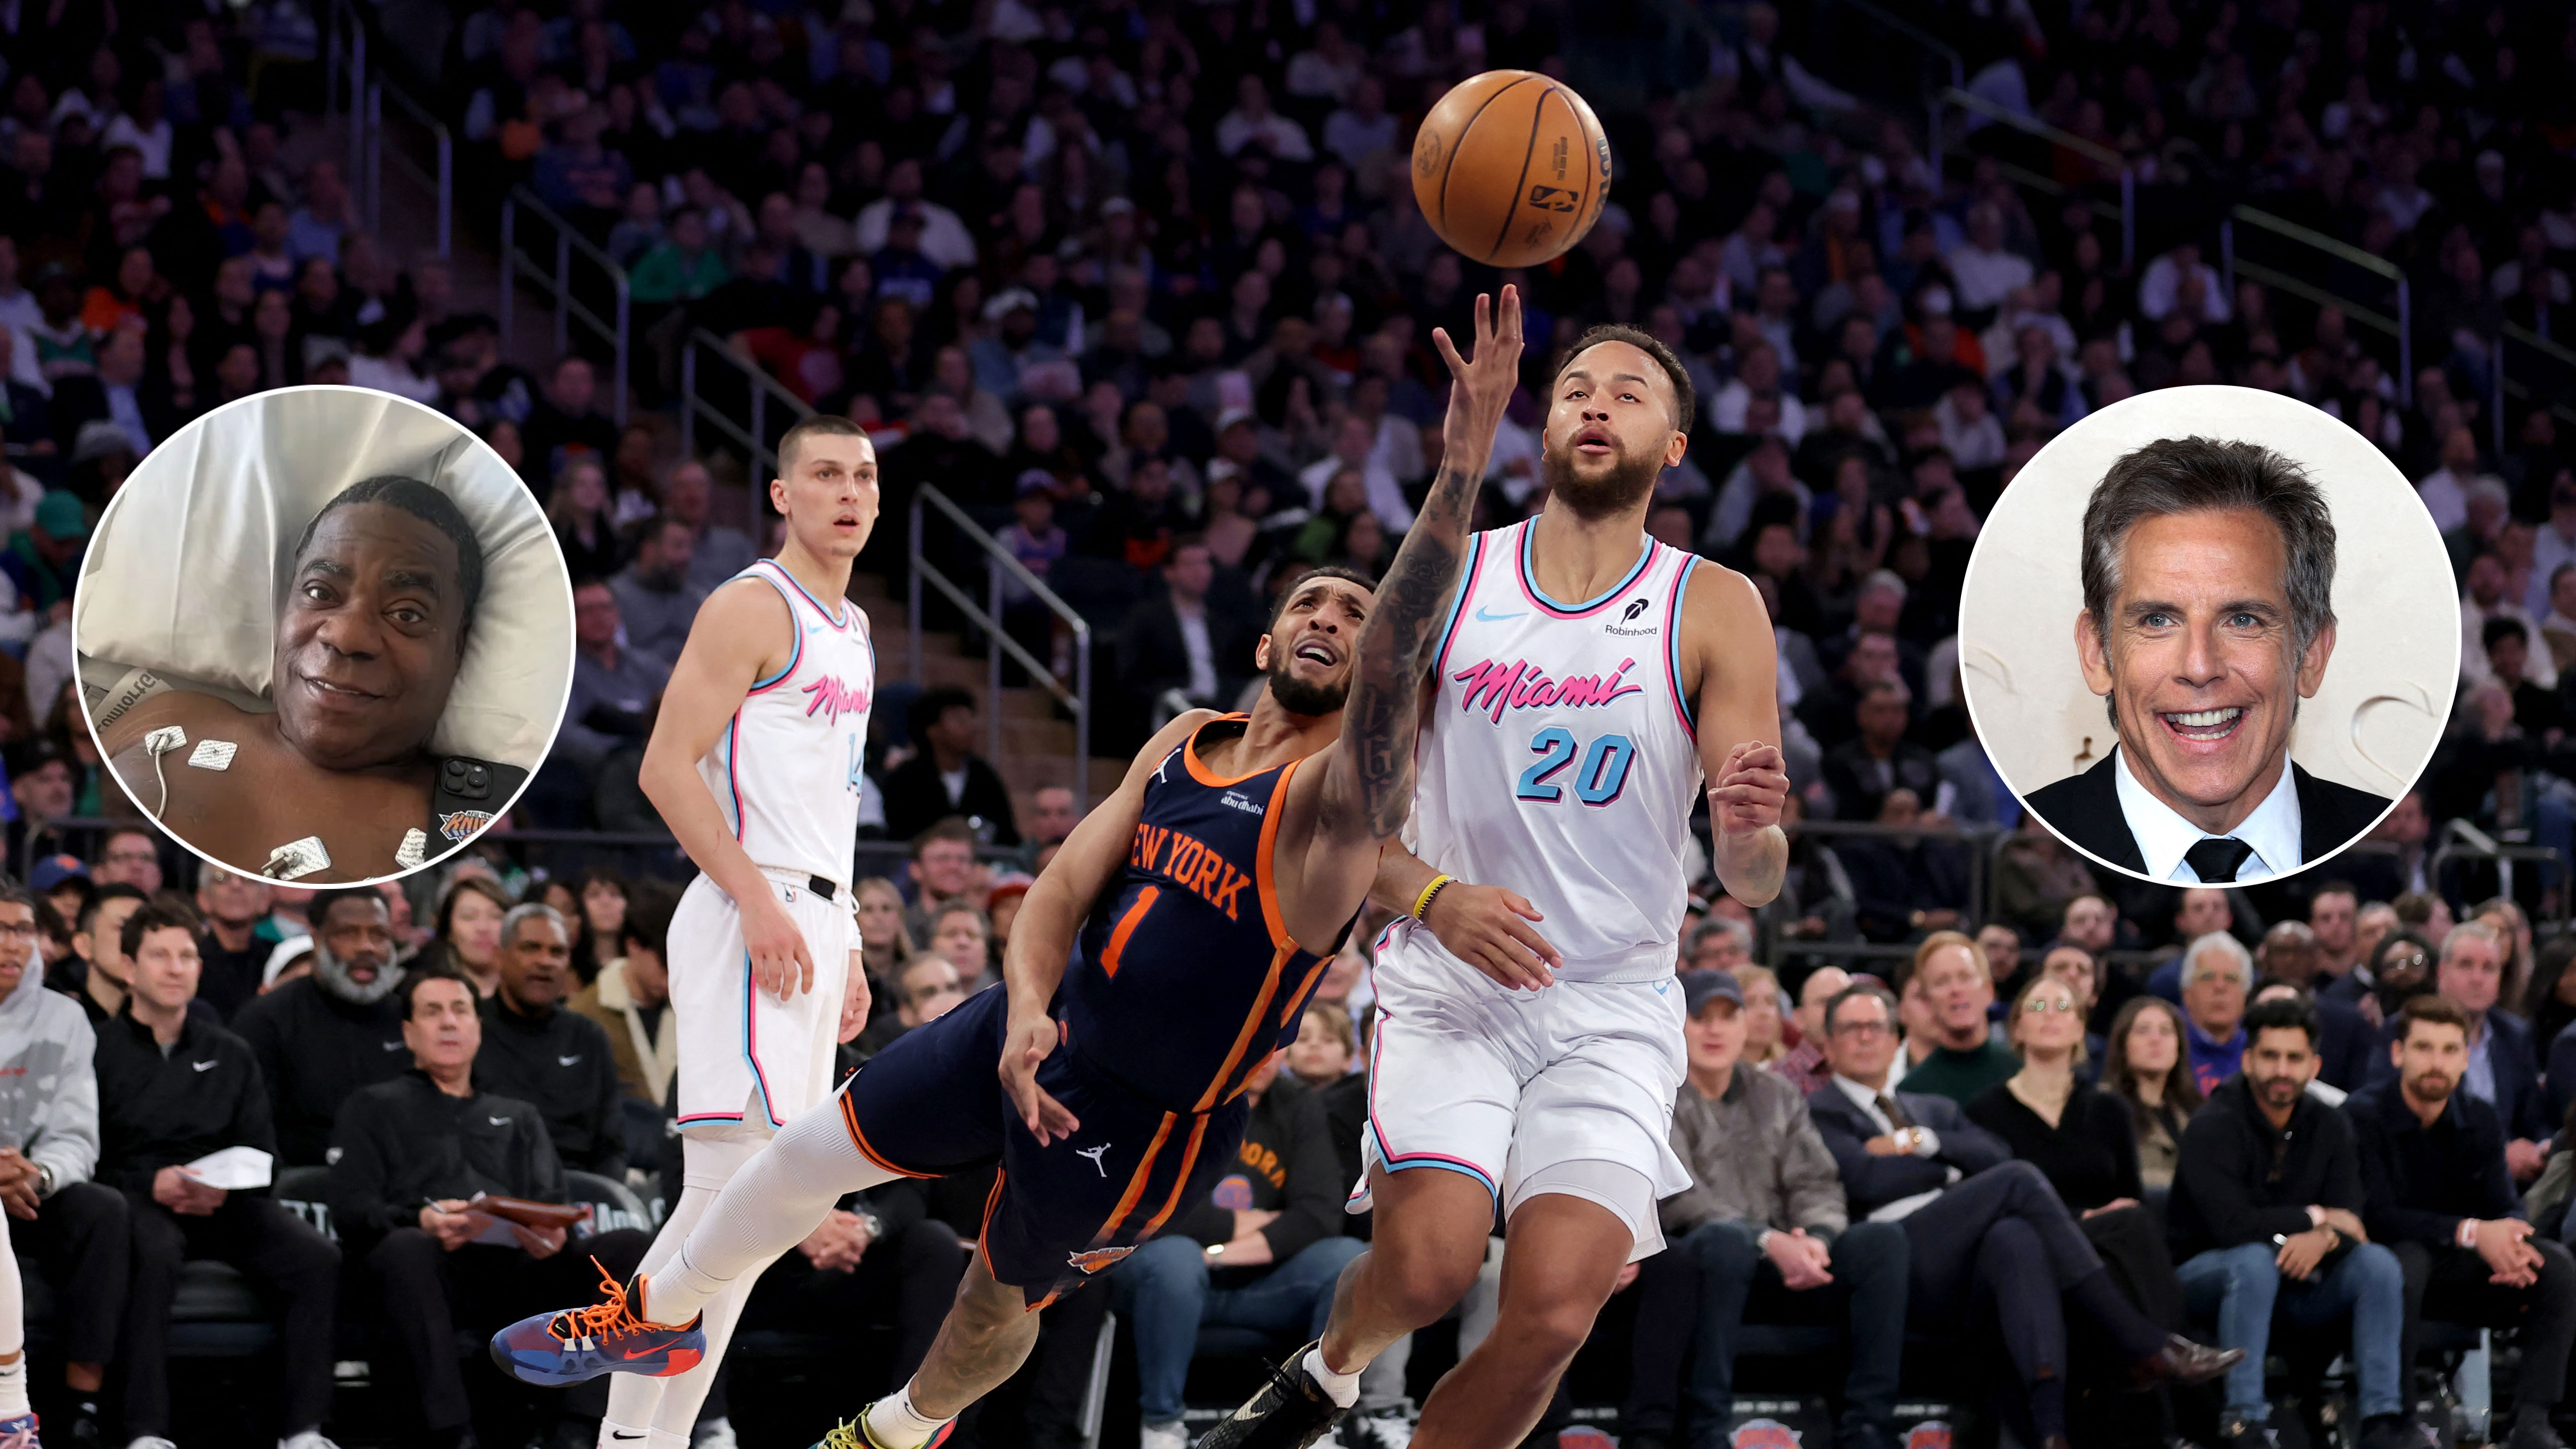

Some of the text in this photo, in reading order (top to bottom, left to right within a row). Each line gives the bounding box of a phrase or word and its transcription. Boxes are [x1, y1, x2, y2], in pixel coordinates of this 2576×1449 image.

[1605, 624, 1657, 636] Robinhood
[801, 674, 871, 727] Miami
[1453, 657, 1644, 724] Miami
[1517, 727, 1636, 807] 20
[1221, 796, 1265, 816] abu dhabi
[1163, 832, 1251, 921] YORK
[1099, 884, 1161, 979] 1
